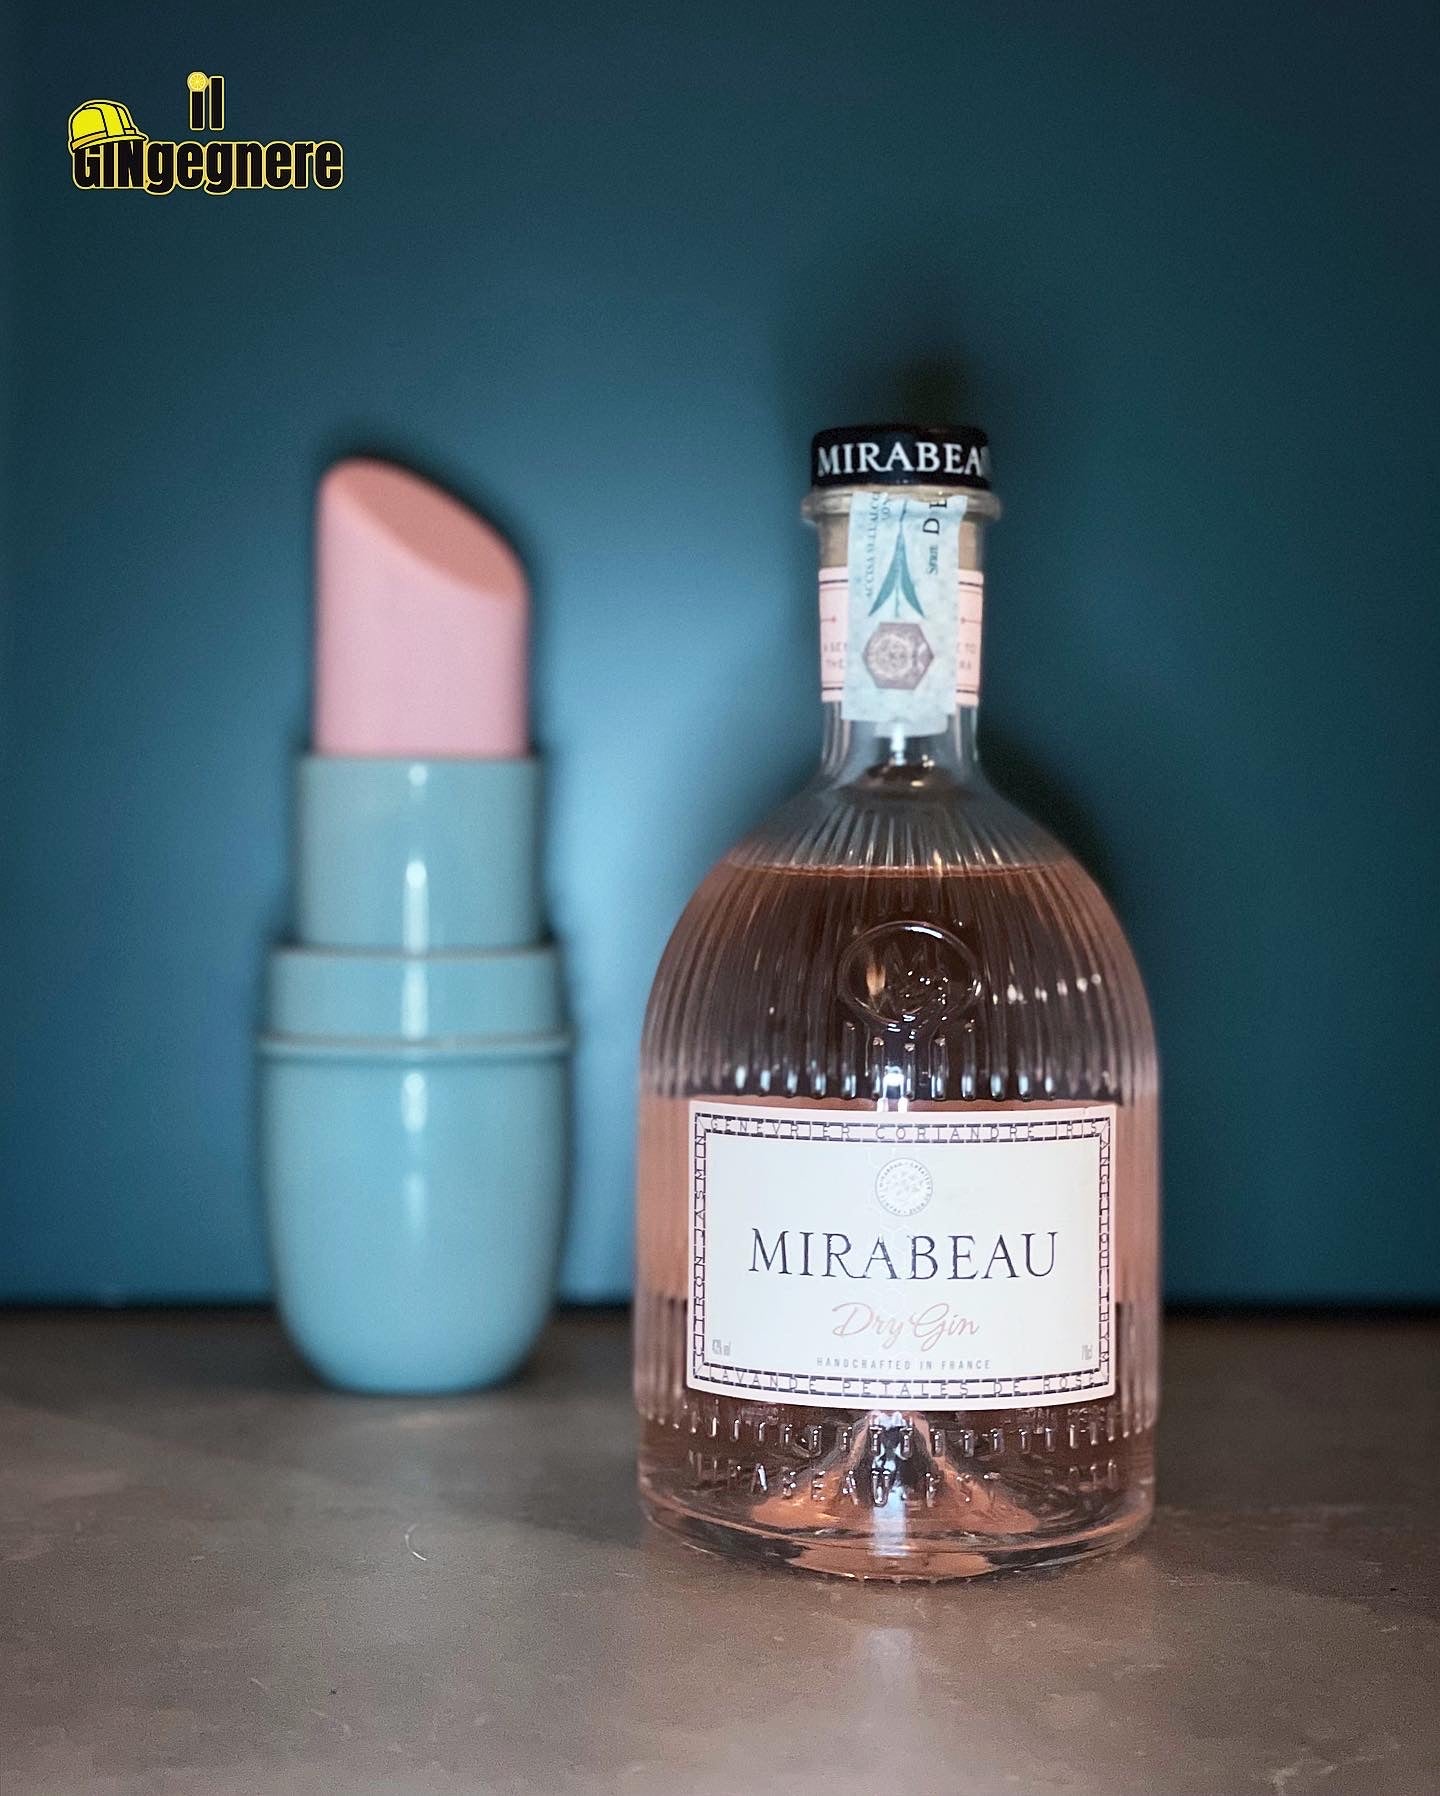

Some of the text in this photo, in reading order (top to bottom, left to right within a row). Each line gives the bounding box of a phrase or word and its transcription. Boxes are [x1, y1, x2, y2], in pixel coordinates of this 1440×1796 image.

[710, 1117, 851, 1140] GENEVRIER
[875, 1123, 1035, 1142] CORIANDRE
[748, 1227, 1058, 1280] MIRABEAU
[832, 1301, 981, 1352] Dry Gin
[816, 1356, 991, 1370] HANDCRAFTED IN FRANCE
[708, 1364, 818, 1393] LAVANDE
[841, 1379, 969, 1398] PETALES
[993, 1379, 1020, 1397] DE
